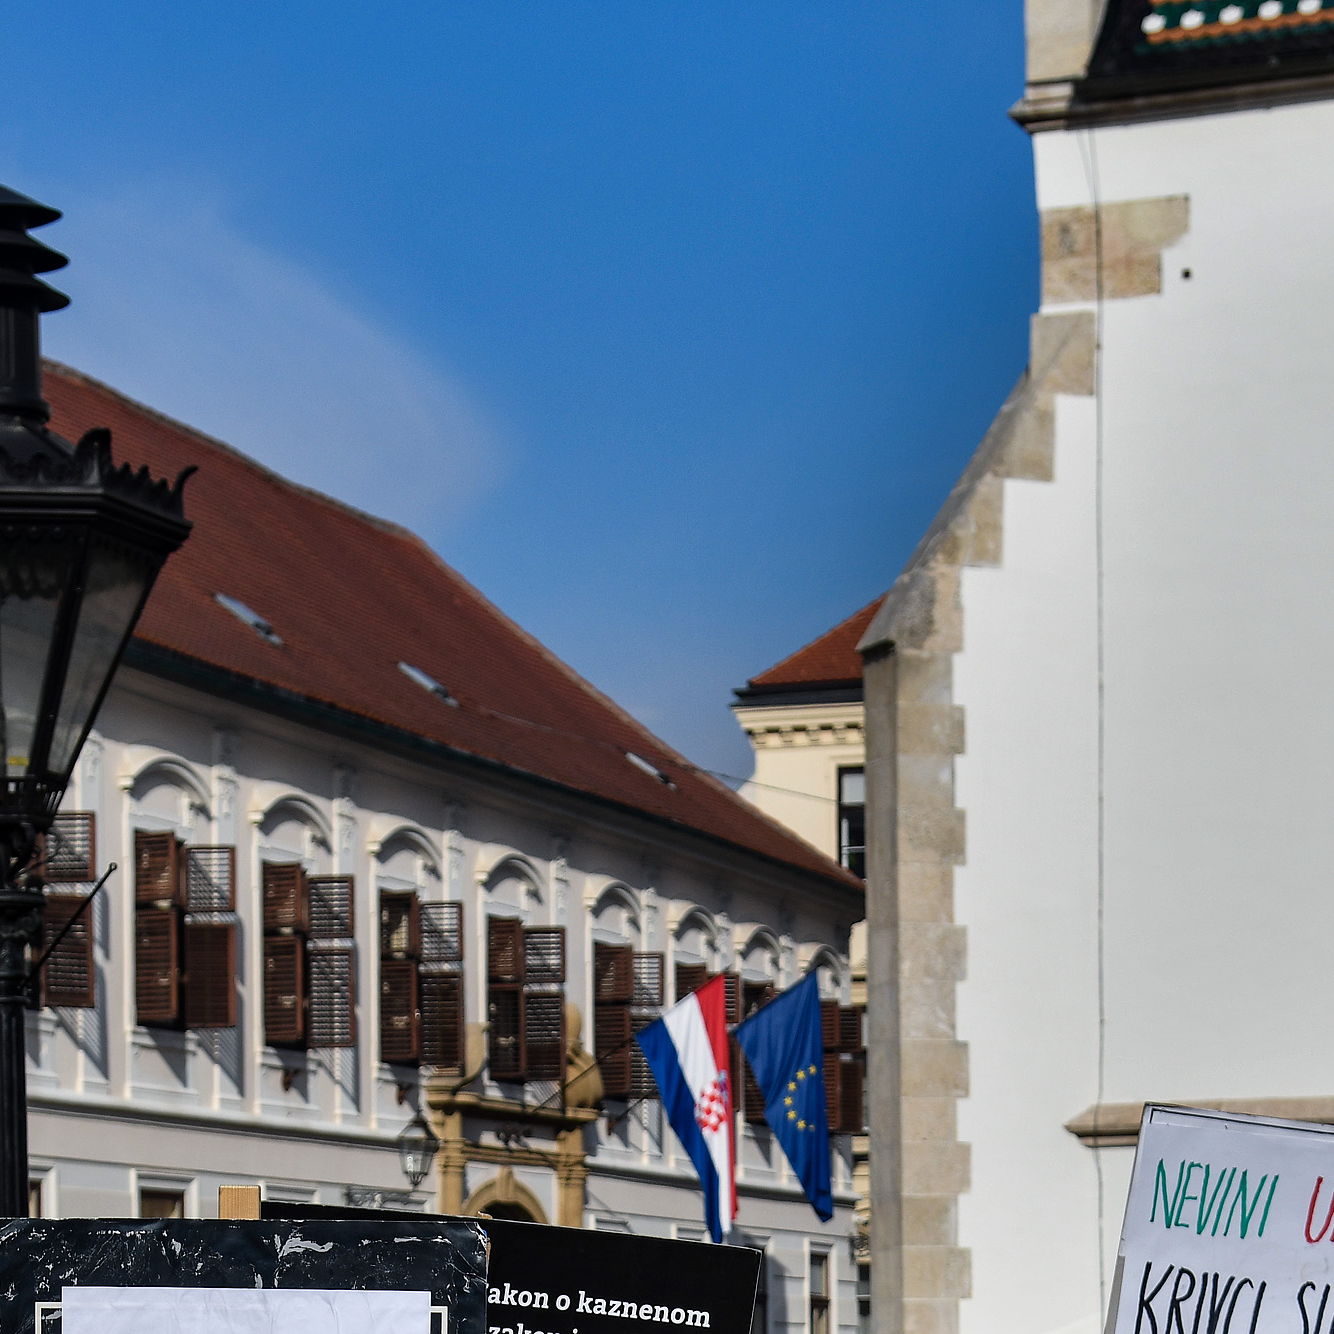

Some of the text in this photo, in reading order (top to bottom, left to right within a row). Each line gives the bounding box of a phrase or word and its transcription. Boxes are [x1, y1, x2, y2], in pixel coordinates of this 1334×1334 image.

[1149, 1157, 1280, 1240] NEVINI
[486, 1279, 711, 1328] akon o kaznenom
